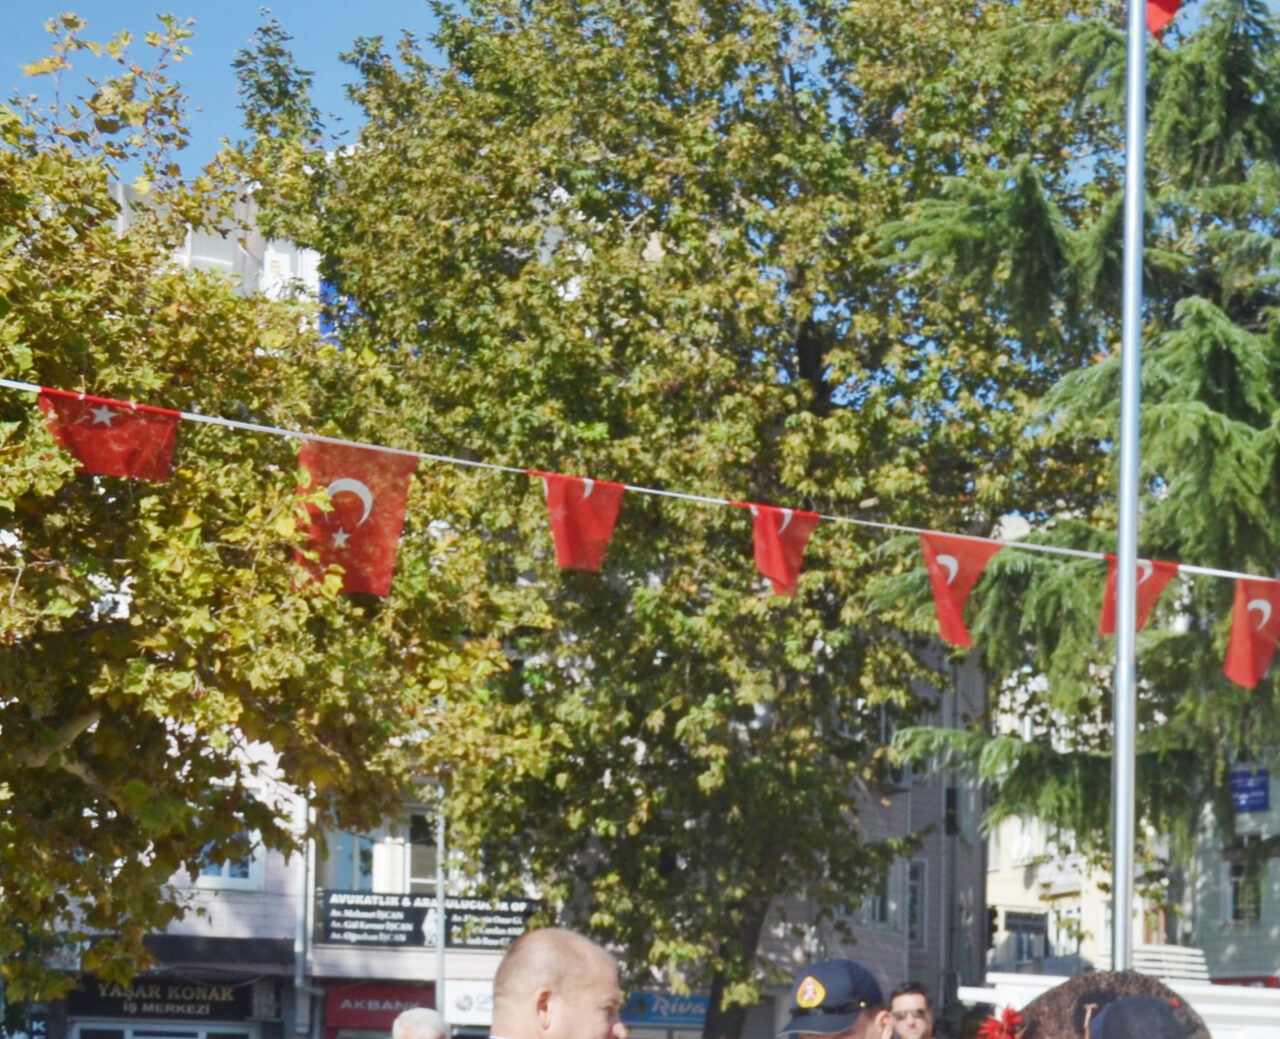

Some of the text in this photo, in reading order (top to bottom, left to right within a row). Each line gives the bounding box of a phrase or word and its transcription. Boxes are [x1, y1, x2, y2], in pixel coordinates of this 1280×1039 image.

[329, 893, 400, 906] AVUKATLIK
[401, 897, 412, 907] &
[98, 984, 235, 1001] YAŞAR KONAK
[122, 1002, 210, 1015] İŞ MERKEZİ
[340, 999, 421, 1012] AKBANK
